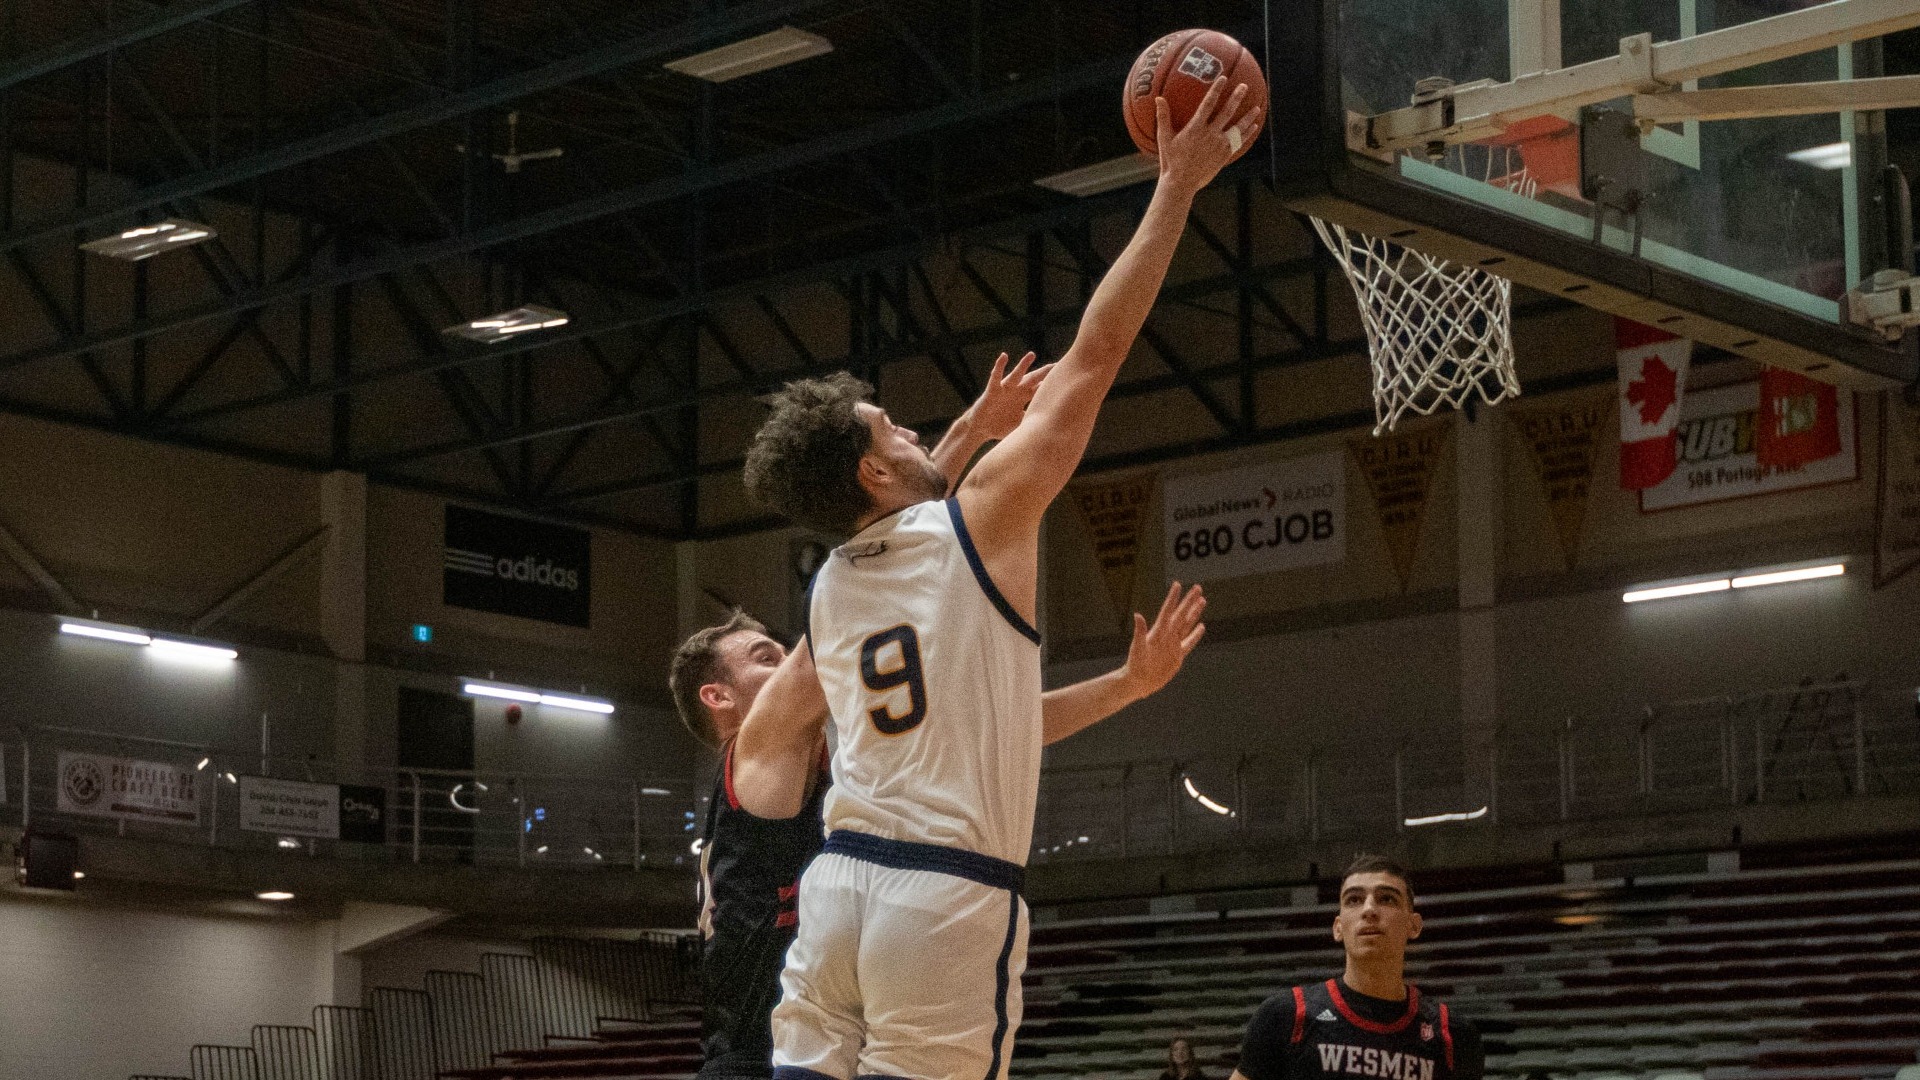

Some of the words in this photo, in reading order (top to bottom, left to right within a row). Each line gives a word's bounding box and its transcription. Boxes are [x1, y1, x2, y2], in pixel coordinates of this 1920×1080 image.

[1283, 483, 1334, 501] RADIO
[1174, 525, 1233, 561] 680
[1242, 509, 1334, 550] CJOB
[497, 554, 578, 591] adidas
[860, 622, 928, 737] 9
[162, 785, 194, 801] BEER
[1317, 1043, 1435, 1080] WESMEN
